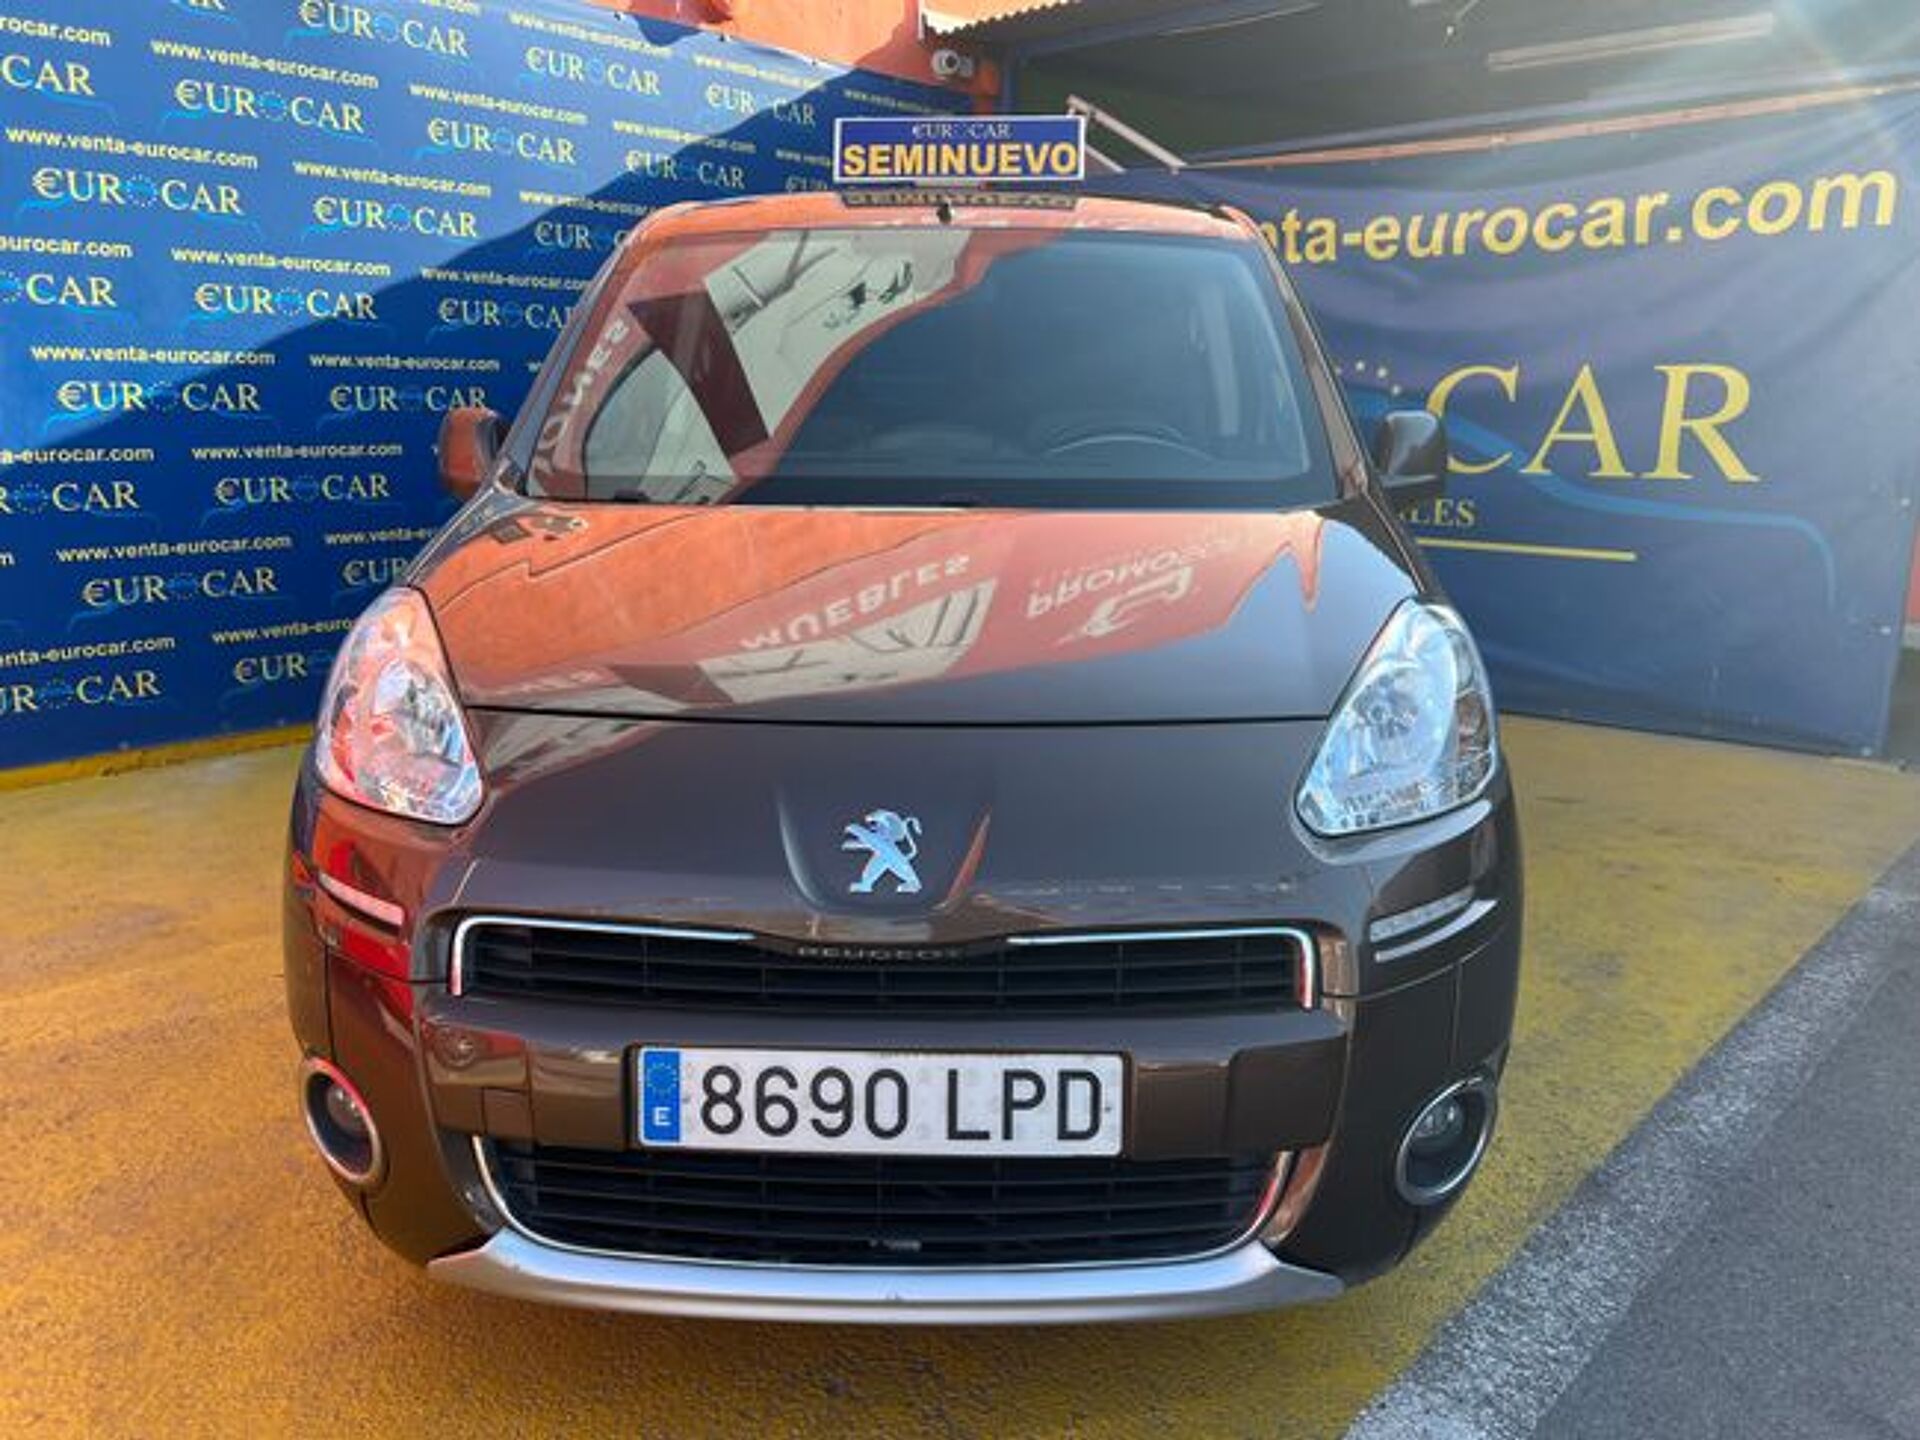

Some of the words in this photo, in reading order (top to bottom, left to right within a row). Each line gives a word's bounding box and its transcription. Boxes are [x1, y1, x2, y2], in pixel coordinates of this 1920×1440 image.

[151, 39, 380, 89] www.venta-eurocar.com
[409, 83, 588, 126] www.venta-eurocar.com
[6, 125, 259, 170] www.venta-eurocar.com
[842, 142, 1078, 177] SEMINUEVO
[292, 160, 492, 198] www.venta-eurocar.com
[171, 246, 392, 278] www.venta-eurocar.com
[31, 345, 276, 366] www.venta-eurocar.com
[309, 353, 501, 371] www.venta-eurocar.com
[191, 443, 402, 462] www.venta-eurocar.com
[56, 533, 292, 563] www.venta-eurocar.com
[652, 1106, 670, 1126] E
[702, 1065, 909, 1139] 8690
[946, 1068, 1102, 1141] LPD
